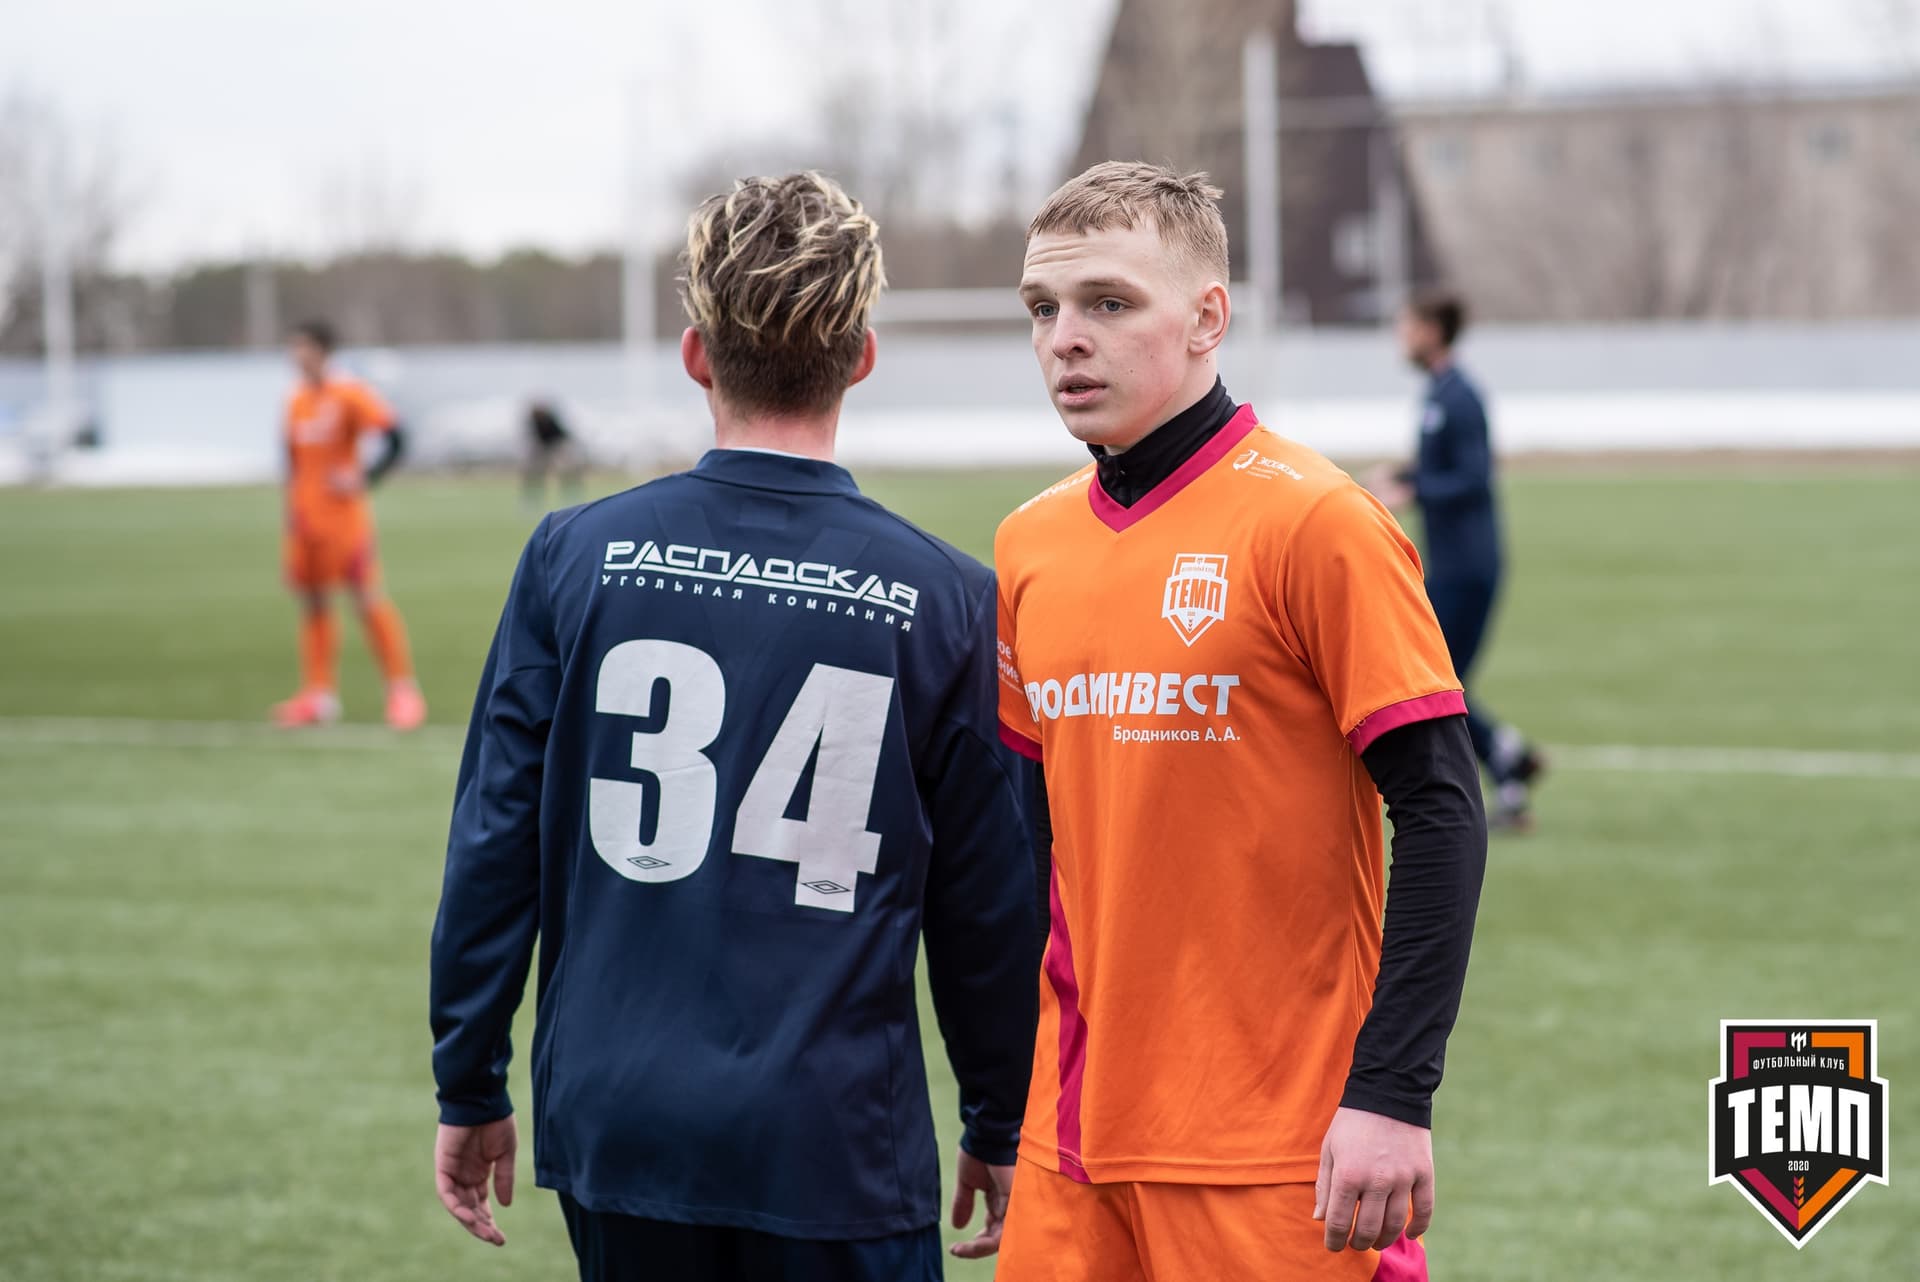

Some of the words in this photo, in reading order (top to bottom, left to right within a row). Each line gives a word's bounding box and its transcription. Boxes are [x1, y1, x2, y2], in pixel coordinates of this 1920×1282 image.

[602, 575, 743, 599] УГОЛЬНАЯ
[768, 593, 912, 631] КОМПАНИЯ
[604, 541, 919, 614] РАСПАДСКАЯ
[1168, 578, 1222, 613] ТЕМП
[1113, 725, 1199, 744] Бродников
[1204, 726, 1240, 742] А.А.
[589, 638, 895, 912] 34
